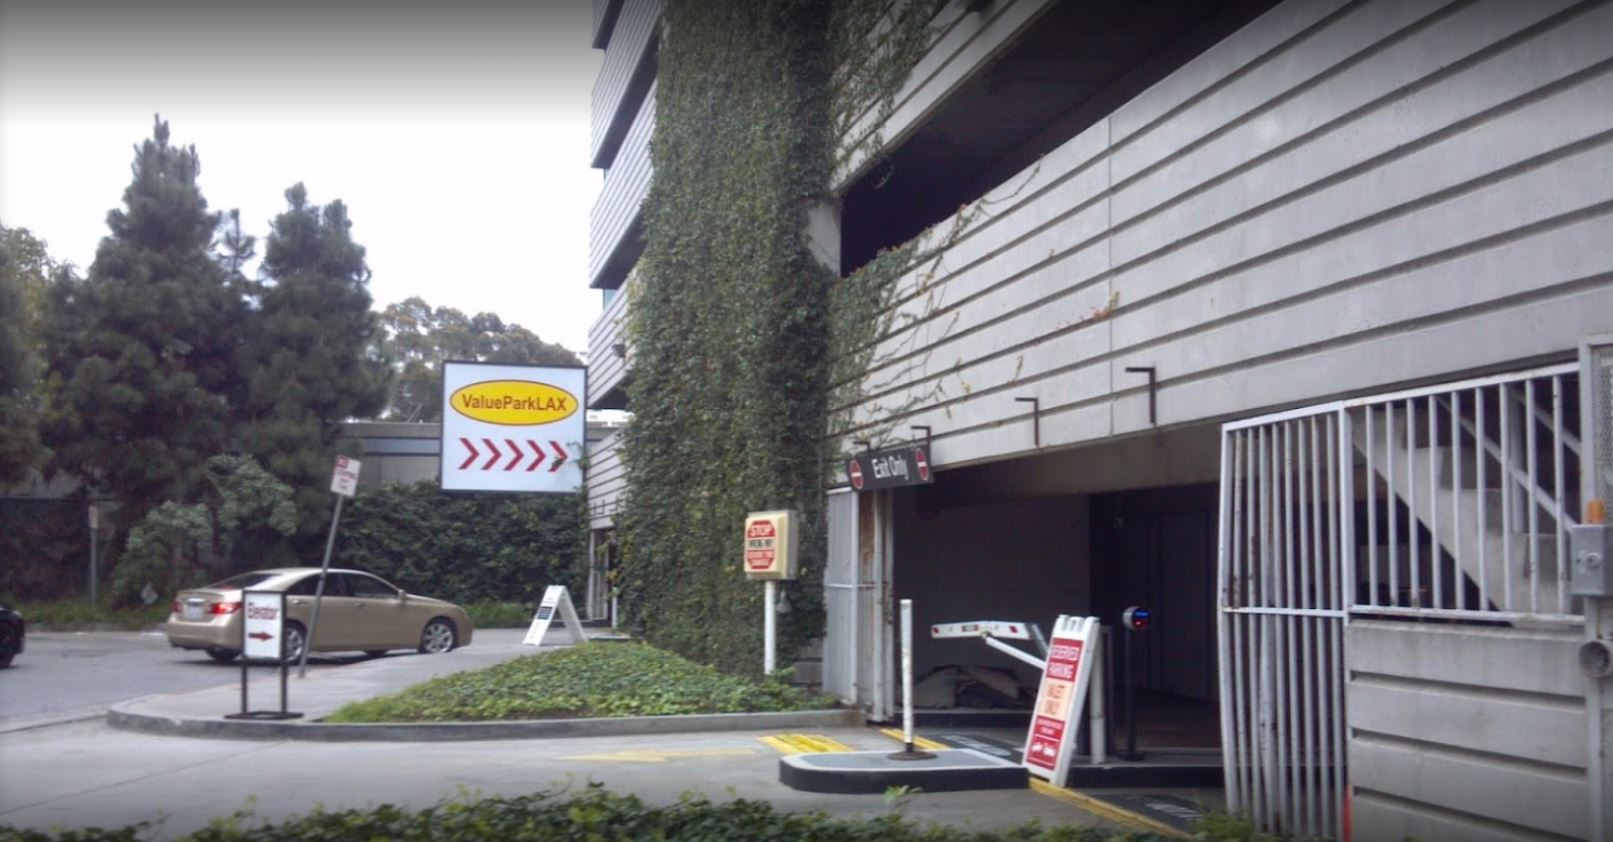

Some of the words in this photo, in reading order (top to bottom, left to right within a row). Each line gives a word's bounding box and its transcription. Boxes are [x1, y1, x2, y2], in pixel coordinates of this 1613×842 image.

[462, 393, 567, 412] ValueParkLAX
[872, 456, 891, 479] Exit
[888, 454, 909, 481] Only
[749, 525, 771, 537] STOP
[247, 601, 278, 620] Elevator
